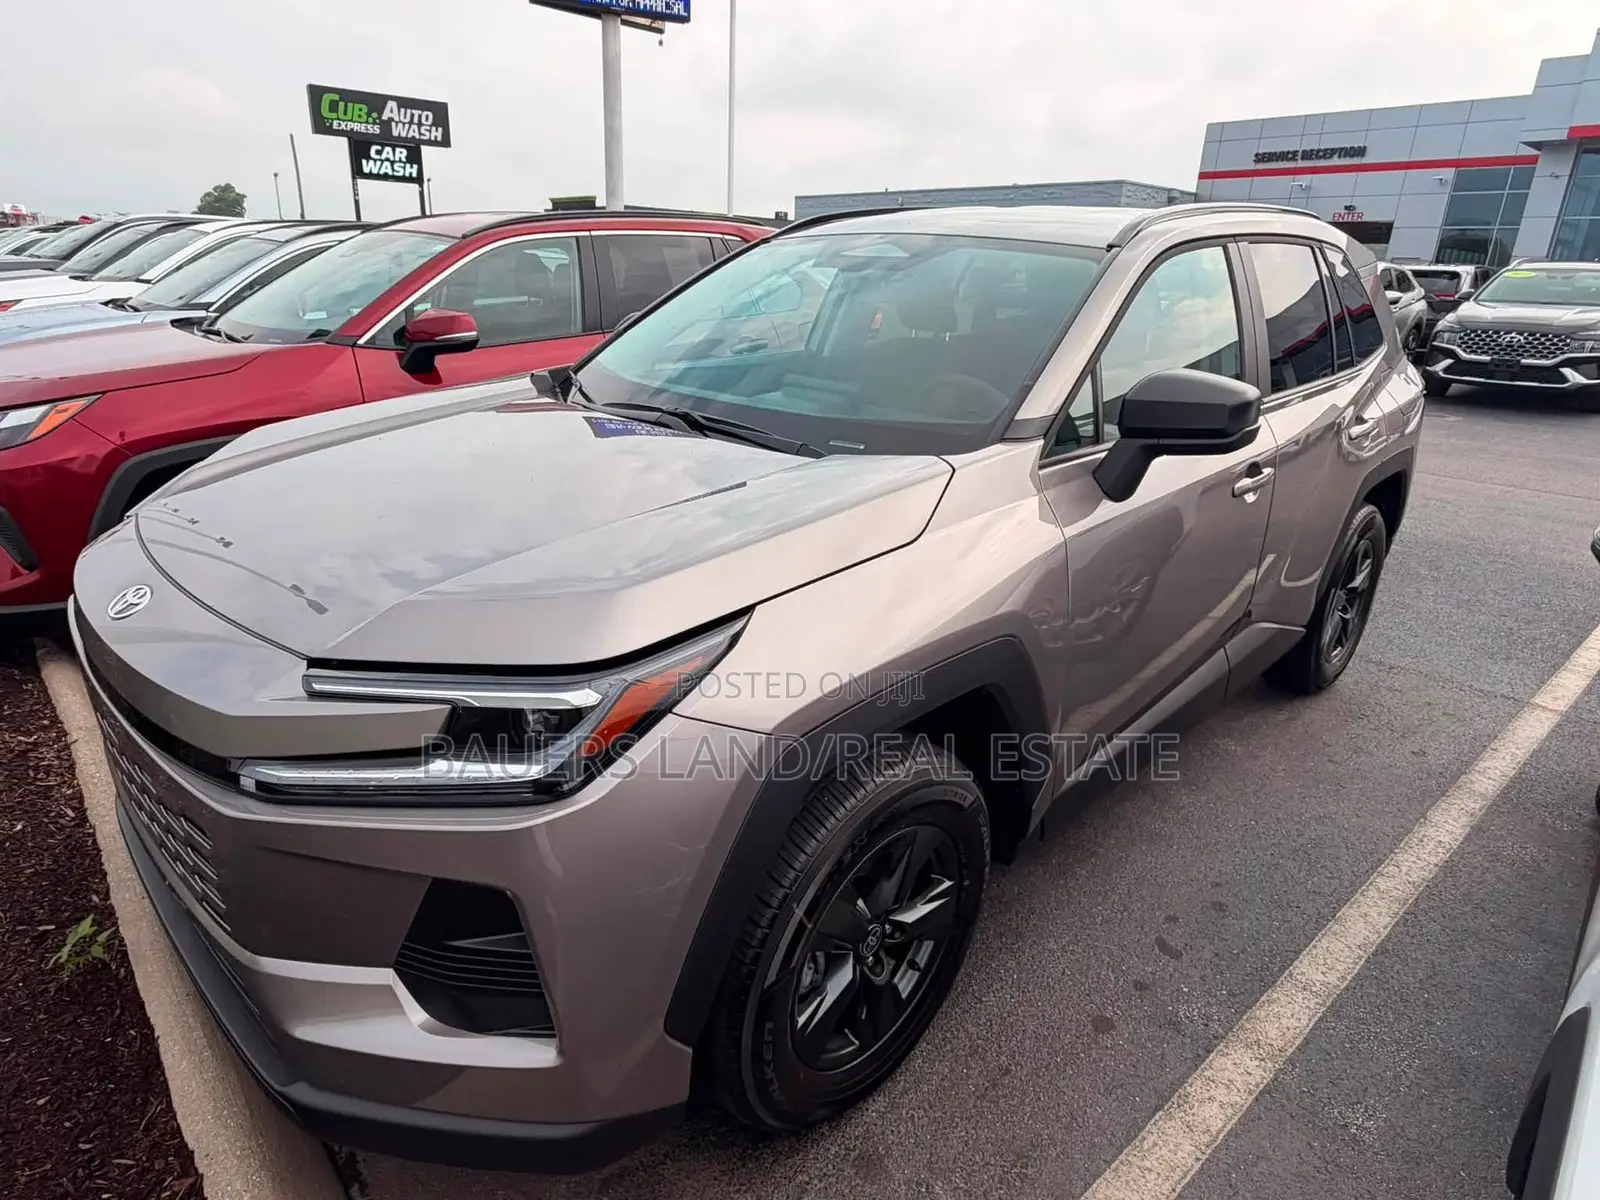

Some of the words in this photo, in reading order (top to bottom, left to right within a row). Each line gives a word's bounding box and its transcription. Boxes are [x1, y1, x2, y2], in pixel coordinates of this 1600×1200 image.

[381, 100, 433, 126] AUTO
[332, 120, 381, 134] EXPRESS
[391, 121, 443, 142] WASH
[370, 145, 407, 162] CAR
[1253, 150, 1300, 164] SERVICE
[1300, 145, 1367, 161] RECEPTION
[361, 159, 418, 178] WASH
[1332, 211, 1364, 221] ENTER
